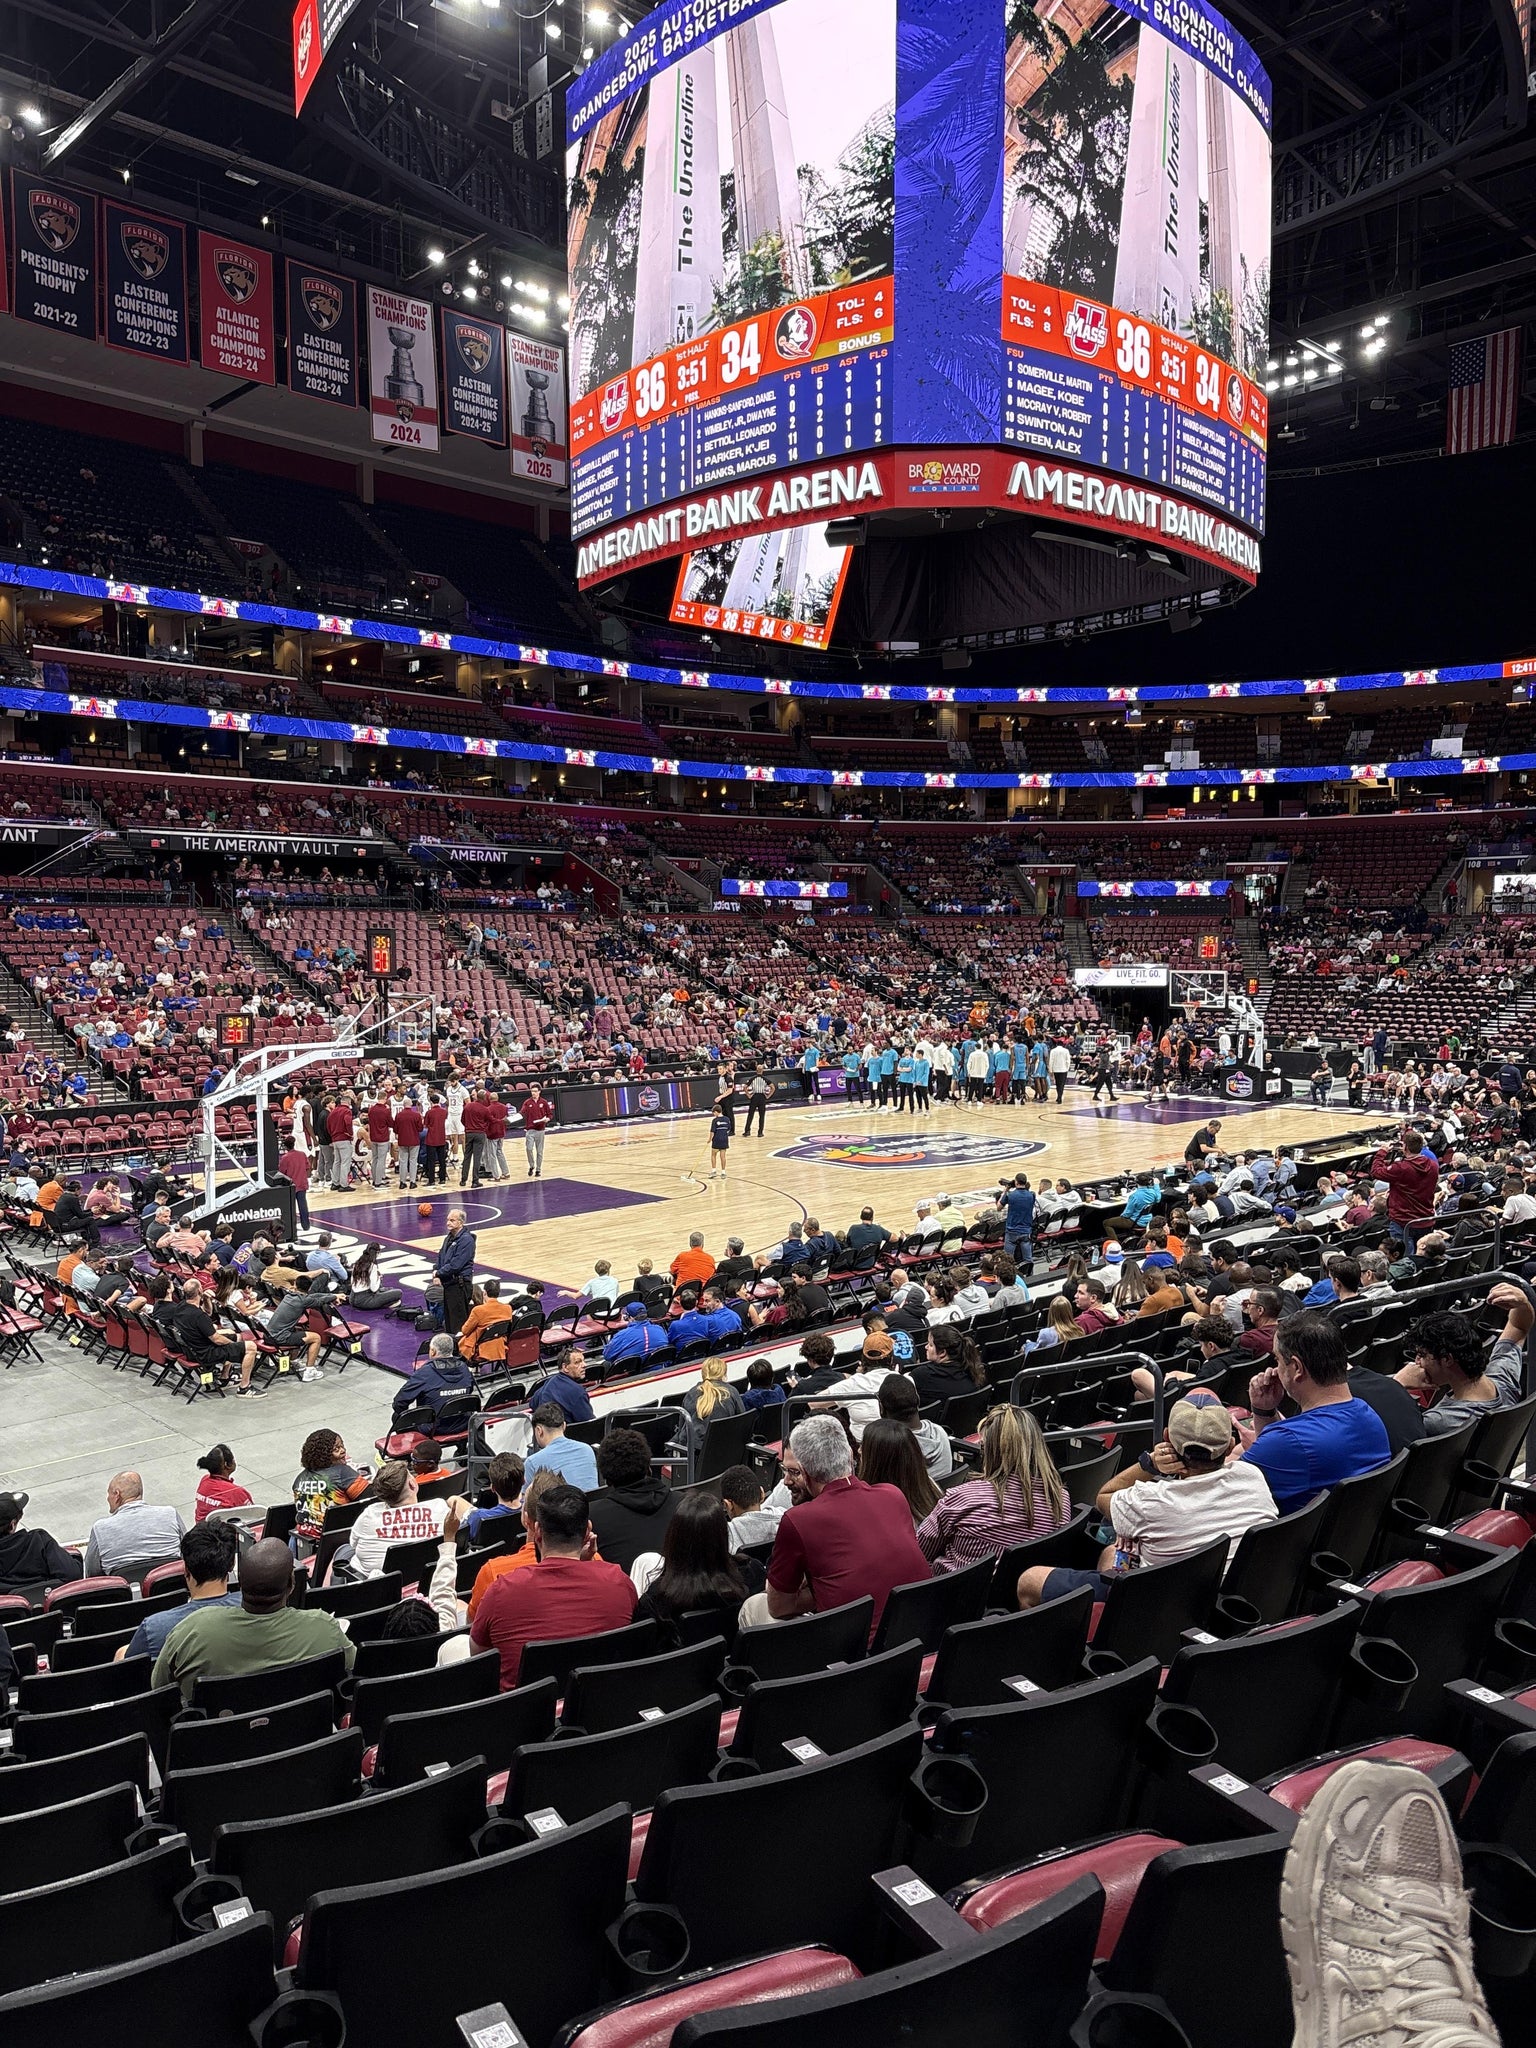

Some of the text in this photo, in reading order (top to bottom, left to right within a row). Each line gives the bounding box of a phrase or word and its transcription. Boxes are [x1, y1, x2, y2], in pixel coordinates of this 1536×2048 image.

[624, 29, 657, 67] 2025
[1153, 0, 1269, 124] BASKETBALL CLASSIC
[572, 50, 658, 132] ORANGEBOWL
[1164, 62, 1180, 258] The Underline
[677, 73, 694, 273] The Underline
[35, 195, 75, 215] FLORIDA
[127, 226, 164, 245] FLORIDA
[21, 248, 89, 281] PRESIDENTS'
[219, 253, 254, 270] FLORIDA
[34, 270, 77, 294] TROPHY
[123, 281, 169, 305] EASTERN
[306, 281, 339, 299] FLORIDA
[114, 294, 179, 322] CONFERENCE
[372, 292, 428, 319] STANLEY CUP
[836, 291, 884, 313] TOL: 4
[1011, 296, 1052, 317] TOL: 4
[34, 302, 78, 327] 2021-22
[116, 310, 177, 338] CHAMPIONS
[216, 306, 260, 330] ATLANTIC
[375, 308, 427, 331] CHAMPIONS
[836, 308, 884, 329] FLS: 6
[1010, 313, 1052, 333] FLS: 8
[126, 328, 169, 350] 2022-23
[217, 321, 259, 344] DIVISION
[459, 326, 489, 342] FLORIDA
[1066, 315, 1106, 344] MASS
[210, 334, 266, 360] CHAMPIONS
[303, 333, 342, 355] EASTERN
[511, 338, 560, 362] STANLEY CUP
[687, 340, 710, 359] HALF
[838, 332, 882, 351] BONUS
[1116, 318, 1151, 379] 36
[219, 351, 259, 373] 2023-24
[295, 345, 350, 372] CONFERENCE
[513, 351, 559, 374] CHAMPIONS
[721, 323, 760, 383] 34
[297, 359, 349, 384] CHAMPIONS
[677, 357, 708, 391] 3:51
[784, 370, 801, 382] PTS
[839, 356, 859, 367] AST
[869, 349, 888, 360] FLS
[1007, 347, 1024, 359] FSU
[1099, 373, 1114, 384] PTS
[1161, 350, 1187, 385] 3:51
[305, 376, 342, 397] 2023-24
[459, 375, 492, 394] EASTERN
[635, 369, 666, 418] 36
[1017, 380, 1085, 407] MAGEE, KOBE
[1195, 354, 1220, 412] 34
[452, 387, 499, 410] CONFERENCE
[454, 400, 498, 422] CHAMPIONS
[588, 409, 594, 418] 4
[1061, 407, 1092, 425] ROBERT
[390, 424, 422, 444] 2024
[461, 415, 492, 433] 2024-25
[735, 421, 777, 441] LEONARDO
[1016, 414, 1083, 438] SWINTON, AJ
[704, 446, 744, 467] PARKER,
[788, 431, 798, 445] 11
[1016, 430, 1053, 449] STEEN,
[1054, 438, 1081, 455] ALEX
[526, 459, 552, 478] 2025
[704, 460, 736, 484] BANKS,
[736, 453, 777, 472] MARCUS
[788, 448, 798, 461] 14
[909, 462, 981, 480] BROWARD
[944, 476, 979, 485] COUNTY
[577, 462, 883, 579] AMERANT BANK ARENA
[1008, 461, 1261, 573] AMERANT BANK ARENA
[722, 611, 738, 631] 36
[760, 619, 775, 638] 34
[0, 828, 39, 842] ANT
[183, 837, 340, 856] THE AMERANT VAULT
[450, 849, 509, 863] AMERANT
[1116, 970, 1134, 978] LIVE.
[1136, 970, 1147, 978] FIT.
[1149, 970, 1160, 978] GO.
[228, 1017, 249, 1028] 3:51
[227, 1029, 243, 1042] 30
[331, 1050, 357, 1058] GEICO
[216, 1207, 282, 1224] AutoNation
[440, 1388, 467, 1397] SECURITY
[298, 1480, 327, 1495] KEEP
[382, 1507, 432, 1526] GATOR
[375, 1523, 439, 1539] NATION
